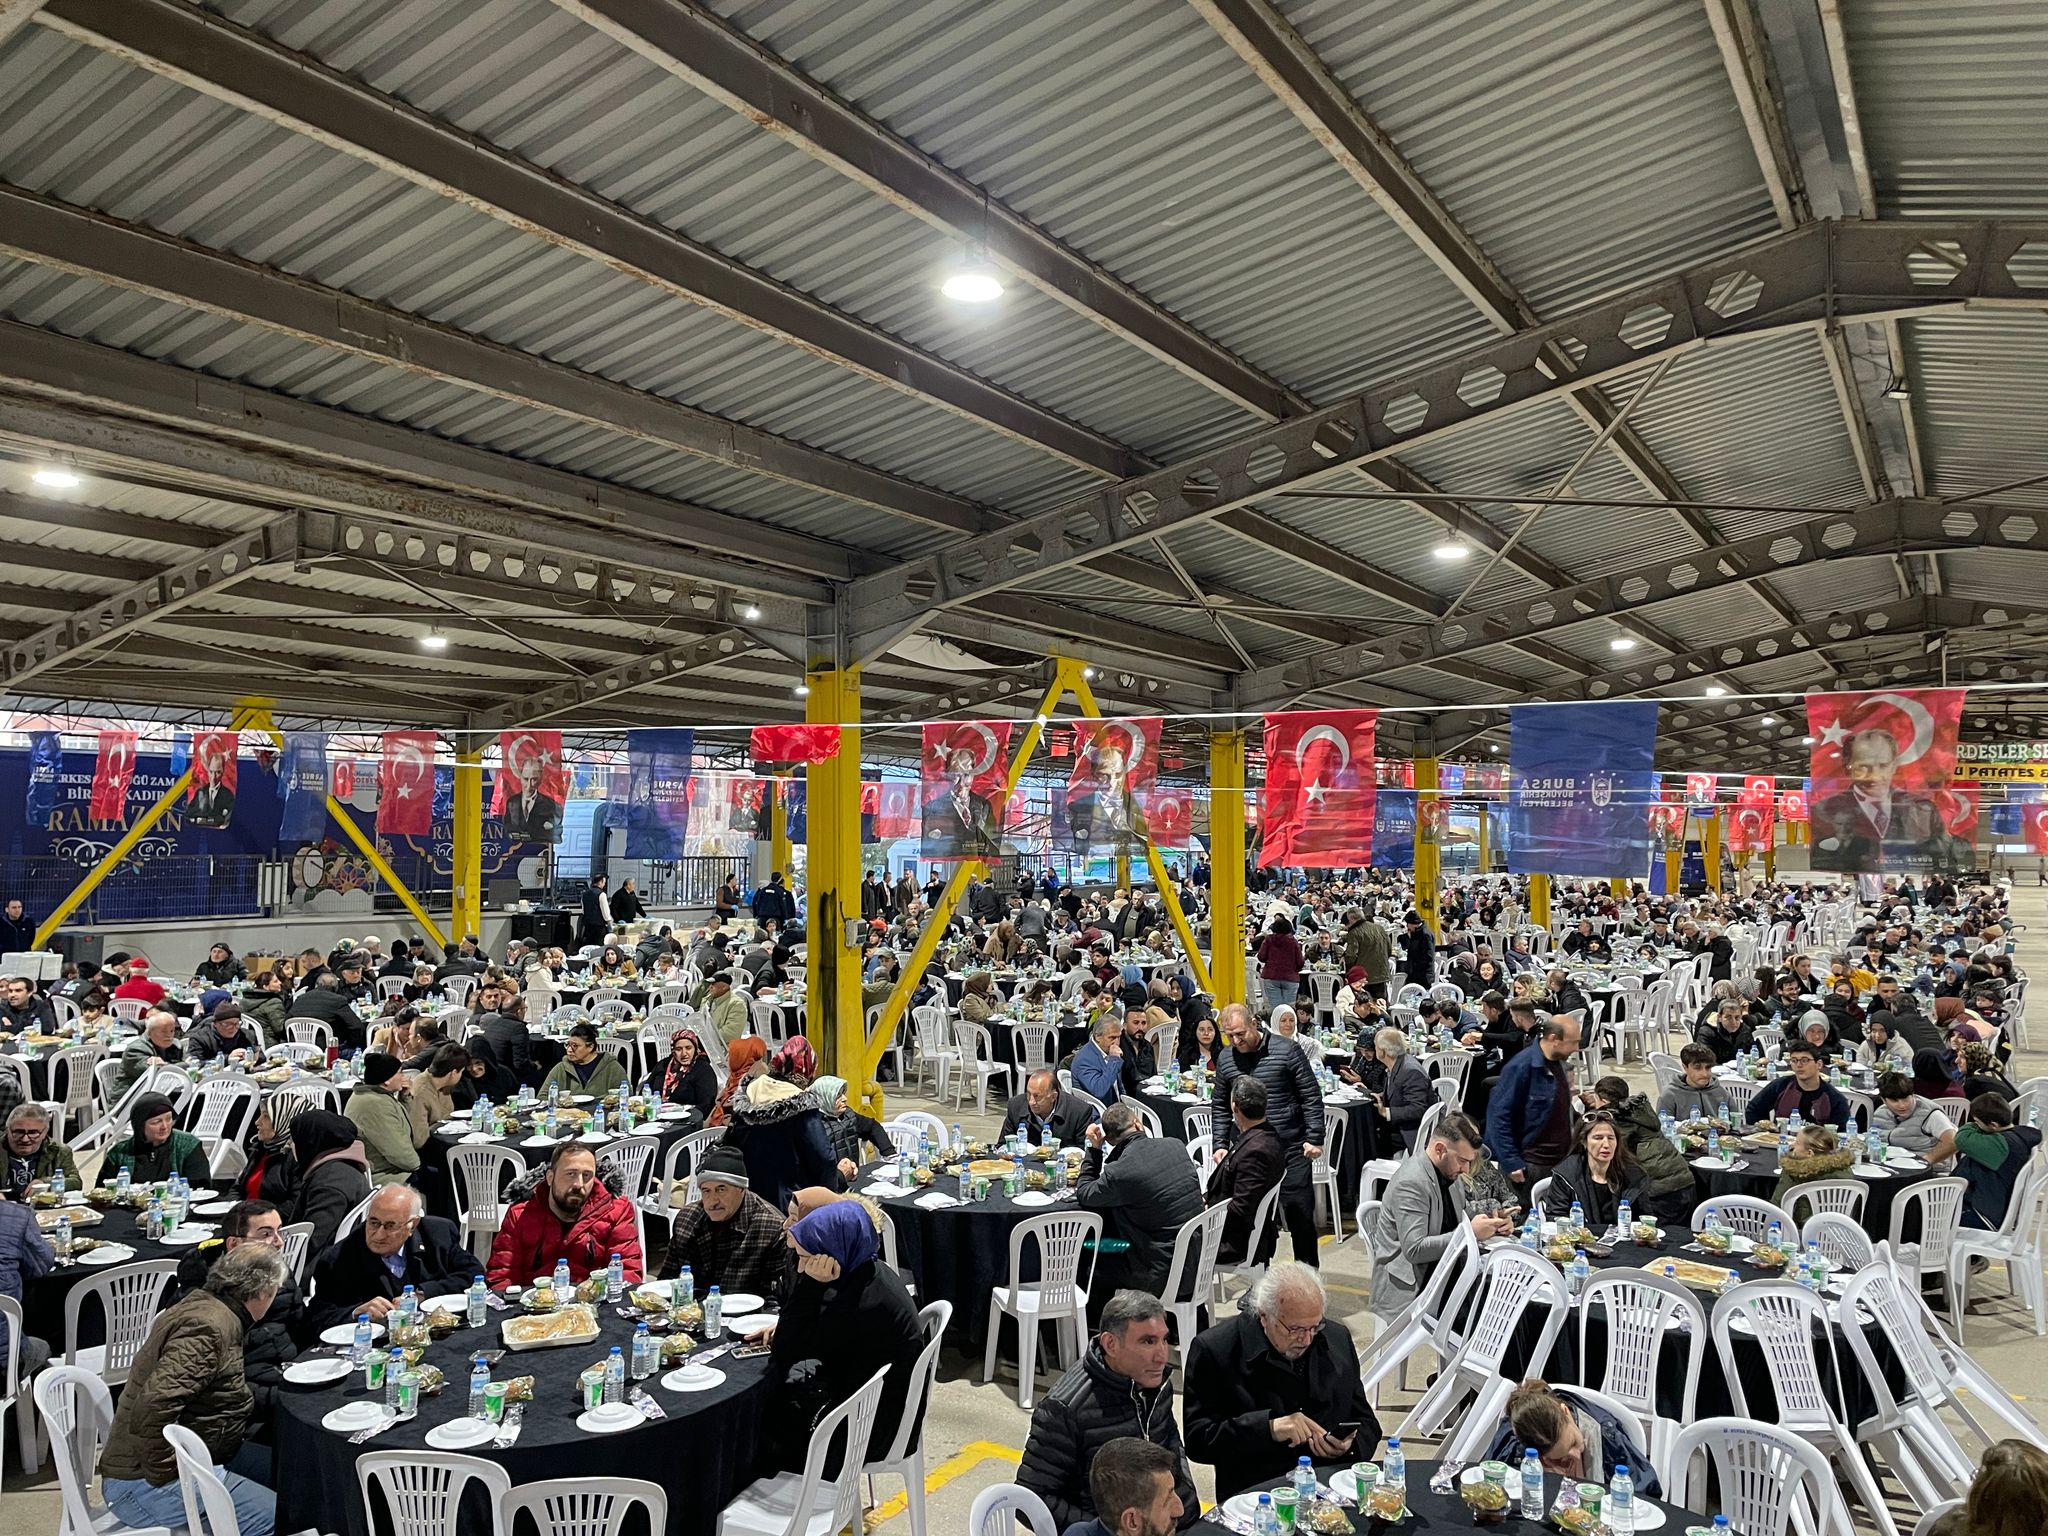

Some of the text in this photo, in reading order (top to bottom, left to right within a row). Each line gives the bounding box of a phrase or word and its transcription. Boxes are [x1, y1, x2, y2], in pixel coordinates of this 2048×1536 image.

[1955, 744, 2029, 759] RDESLER
[1968, 767, 2035, 777] PATATES
[149, 776, 176, 787] ZAM
[653, 780, 684, 789] BURSA
[432, 823, 504, 840] RAAN
